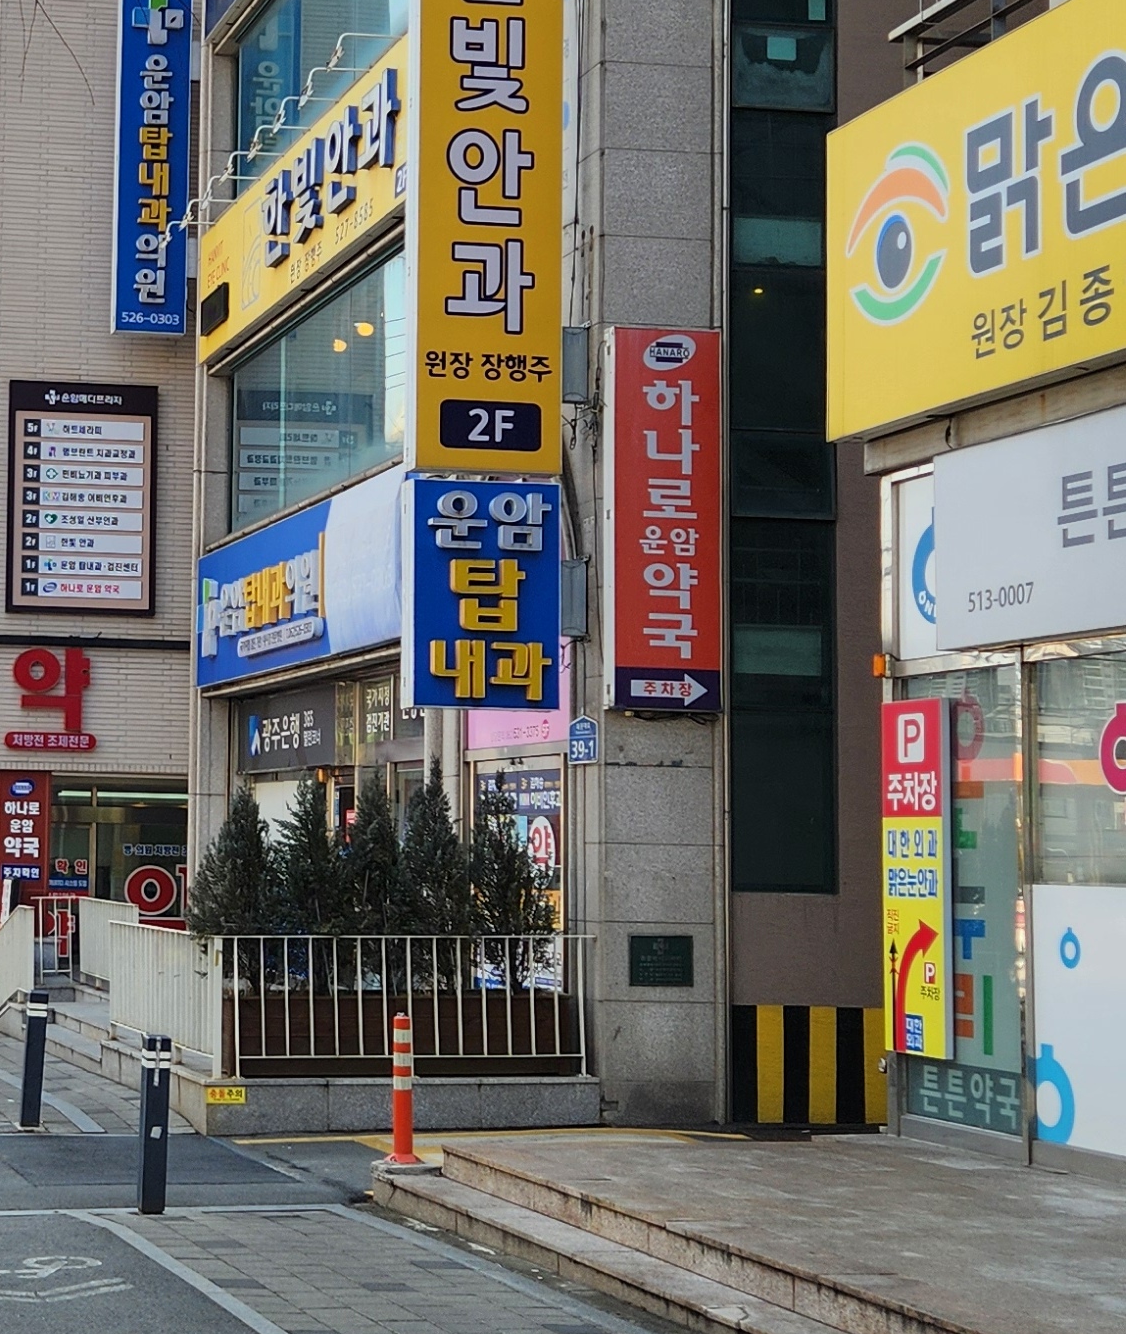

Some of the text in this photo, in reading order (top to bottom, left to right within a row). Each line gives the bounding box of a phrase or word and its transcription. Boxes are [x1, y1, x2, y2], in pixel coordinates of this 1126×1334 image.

[133, 53, 174, 306] 운암탑내과의원
[262, 68, 401, 268] 한빛안과
[121, 310, 180, 326] 526-0303
[971, 297, 1027, 360] 원장
[424, 350, 552, 383] 원장 장행주
[649, 345, 691, 360] HANARO
[468, 408, 516, 444] 2F
[642, 379, 700, 520] 하나로
[428, 490, 552, 551] 운암
[639, 524, 700, 557] 운암
[450, 558, 526, 632] 탑
[642, 561, 699, 660] 약국
[968, 581, 1034, 612] 513-0007
[430, 640, 553, 701] 내과
[13, 647, 91, 732] 약
[643, 680, 693, 698] 주차장
[12, 733, 90, 748] 처방전 조제전문
[262, 715, 300, 753] 광주은행
[571, 739, 595, 759] 39-1
[887, 770, 937, 812] 주차장
[4, 801, 40, 816] 하나로
[10, 819, 34, 834] 운암
[3, 836, 40, 858] 약국
[887, 867, 938, 898] 맑은눈안과
[906, 1017, 923, 1034] 대한
[920, 1064, 1021, 1129] 튼튼약국
